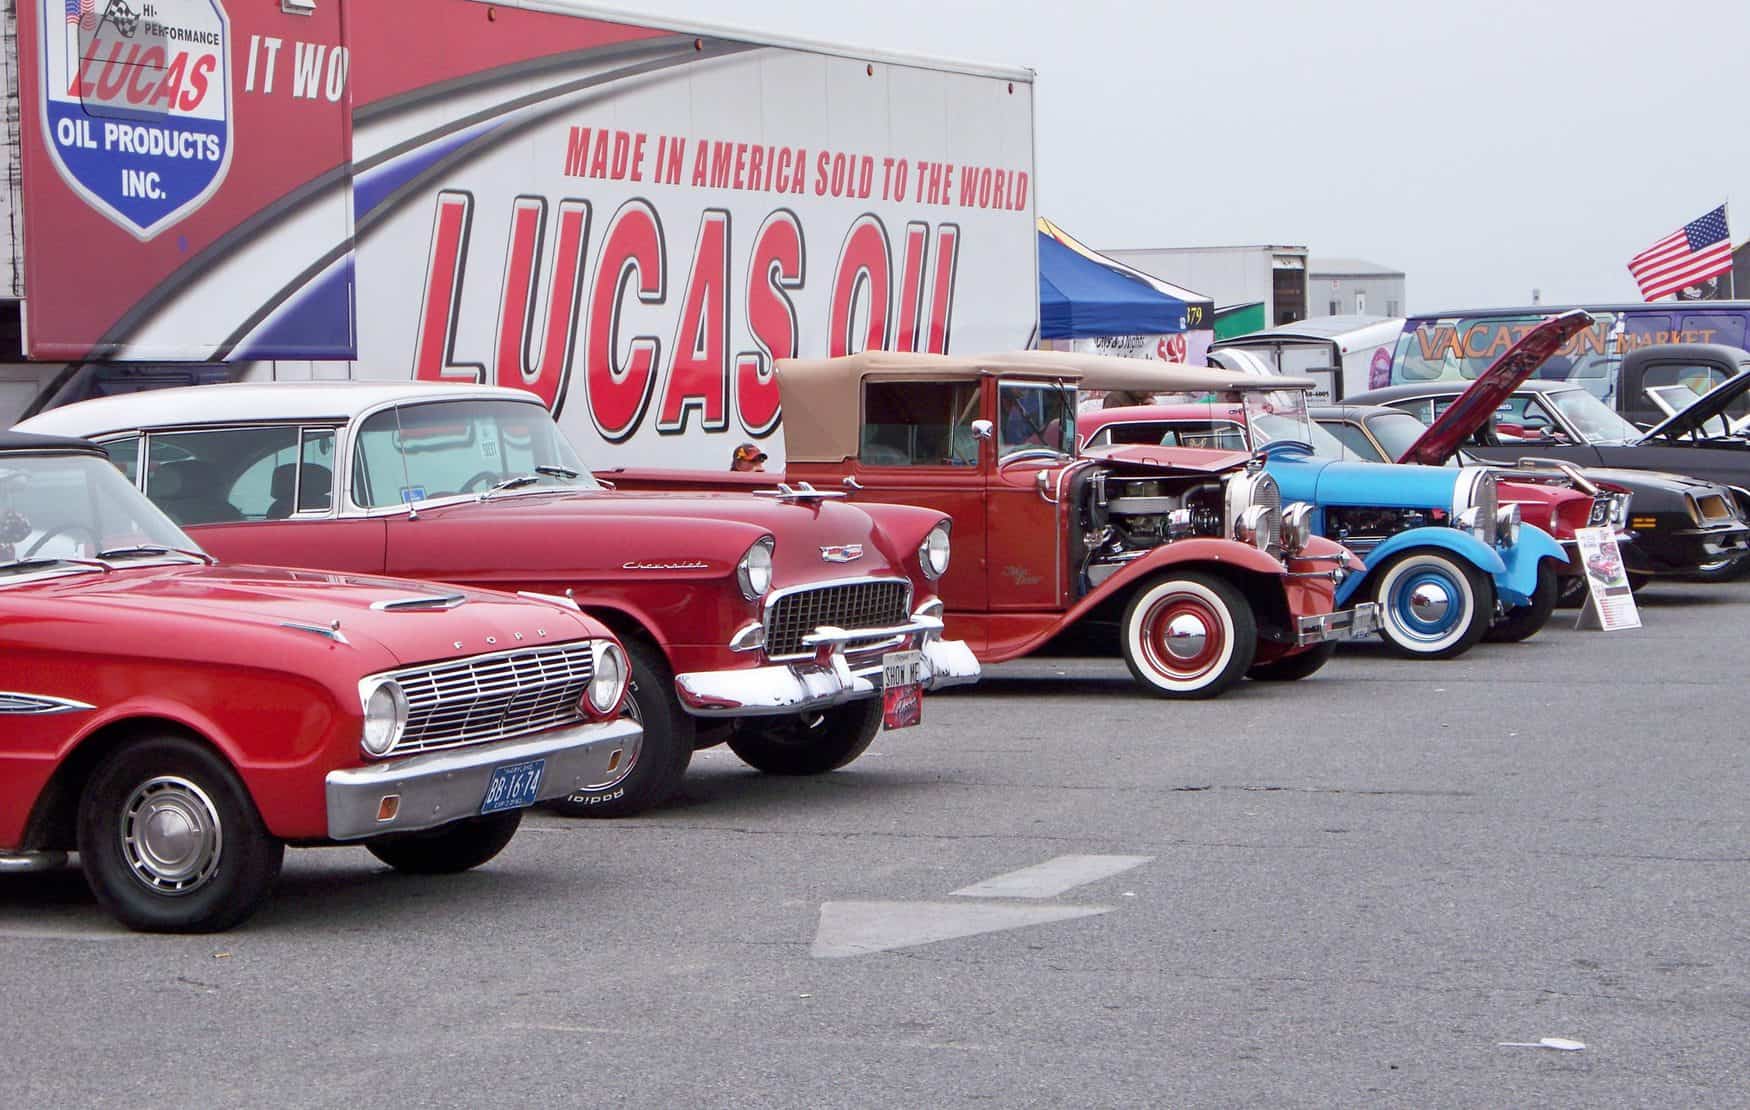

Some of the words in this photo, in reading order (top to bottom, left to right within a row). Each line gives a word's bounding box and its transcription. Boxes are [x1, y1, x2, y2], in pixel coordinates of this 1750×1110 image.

[143, 4, 158, 17] HI-
[144, 23, 220, 46] PERFORMANCE
[67, 38, 217, 112] LUCAS
[245, 35, 282, 94] IT
[57, 117, 98, 149] OIL
[104, 122, 220, 161] PRODUCTS
[122, 168, 167, 200] INC.
[564, 126, 647, 182] MADE
[654, 135, 686, 185] IN
[691, 139, 807, 194] AMERICA
[815, 150, 874, 199] SOLD
[882, 157, 908, 202] TO
[916, 161, 954, 205] THE
[960, 166, 1028, 211] WORLD
[411, 190, 806, 444] LUCAS
[1416, 322, 1610, 360] VACATN
[1612, 329, 1717, 354] MARKET
[622, 560, 709, 569] Chevrolet
[453, 628, 547, 650] FORD
[567, 787, 625, 805] Radial
